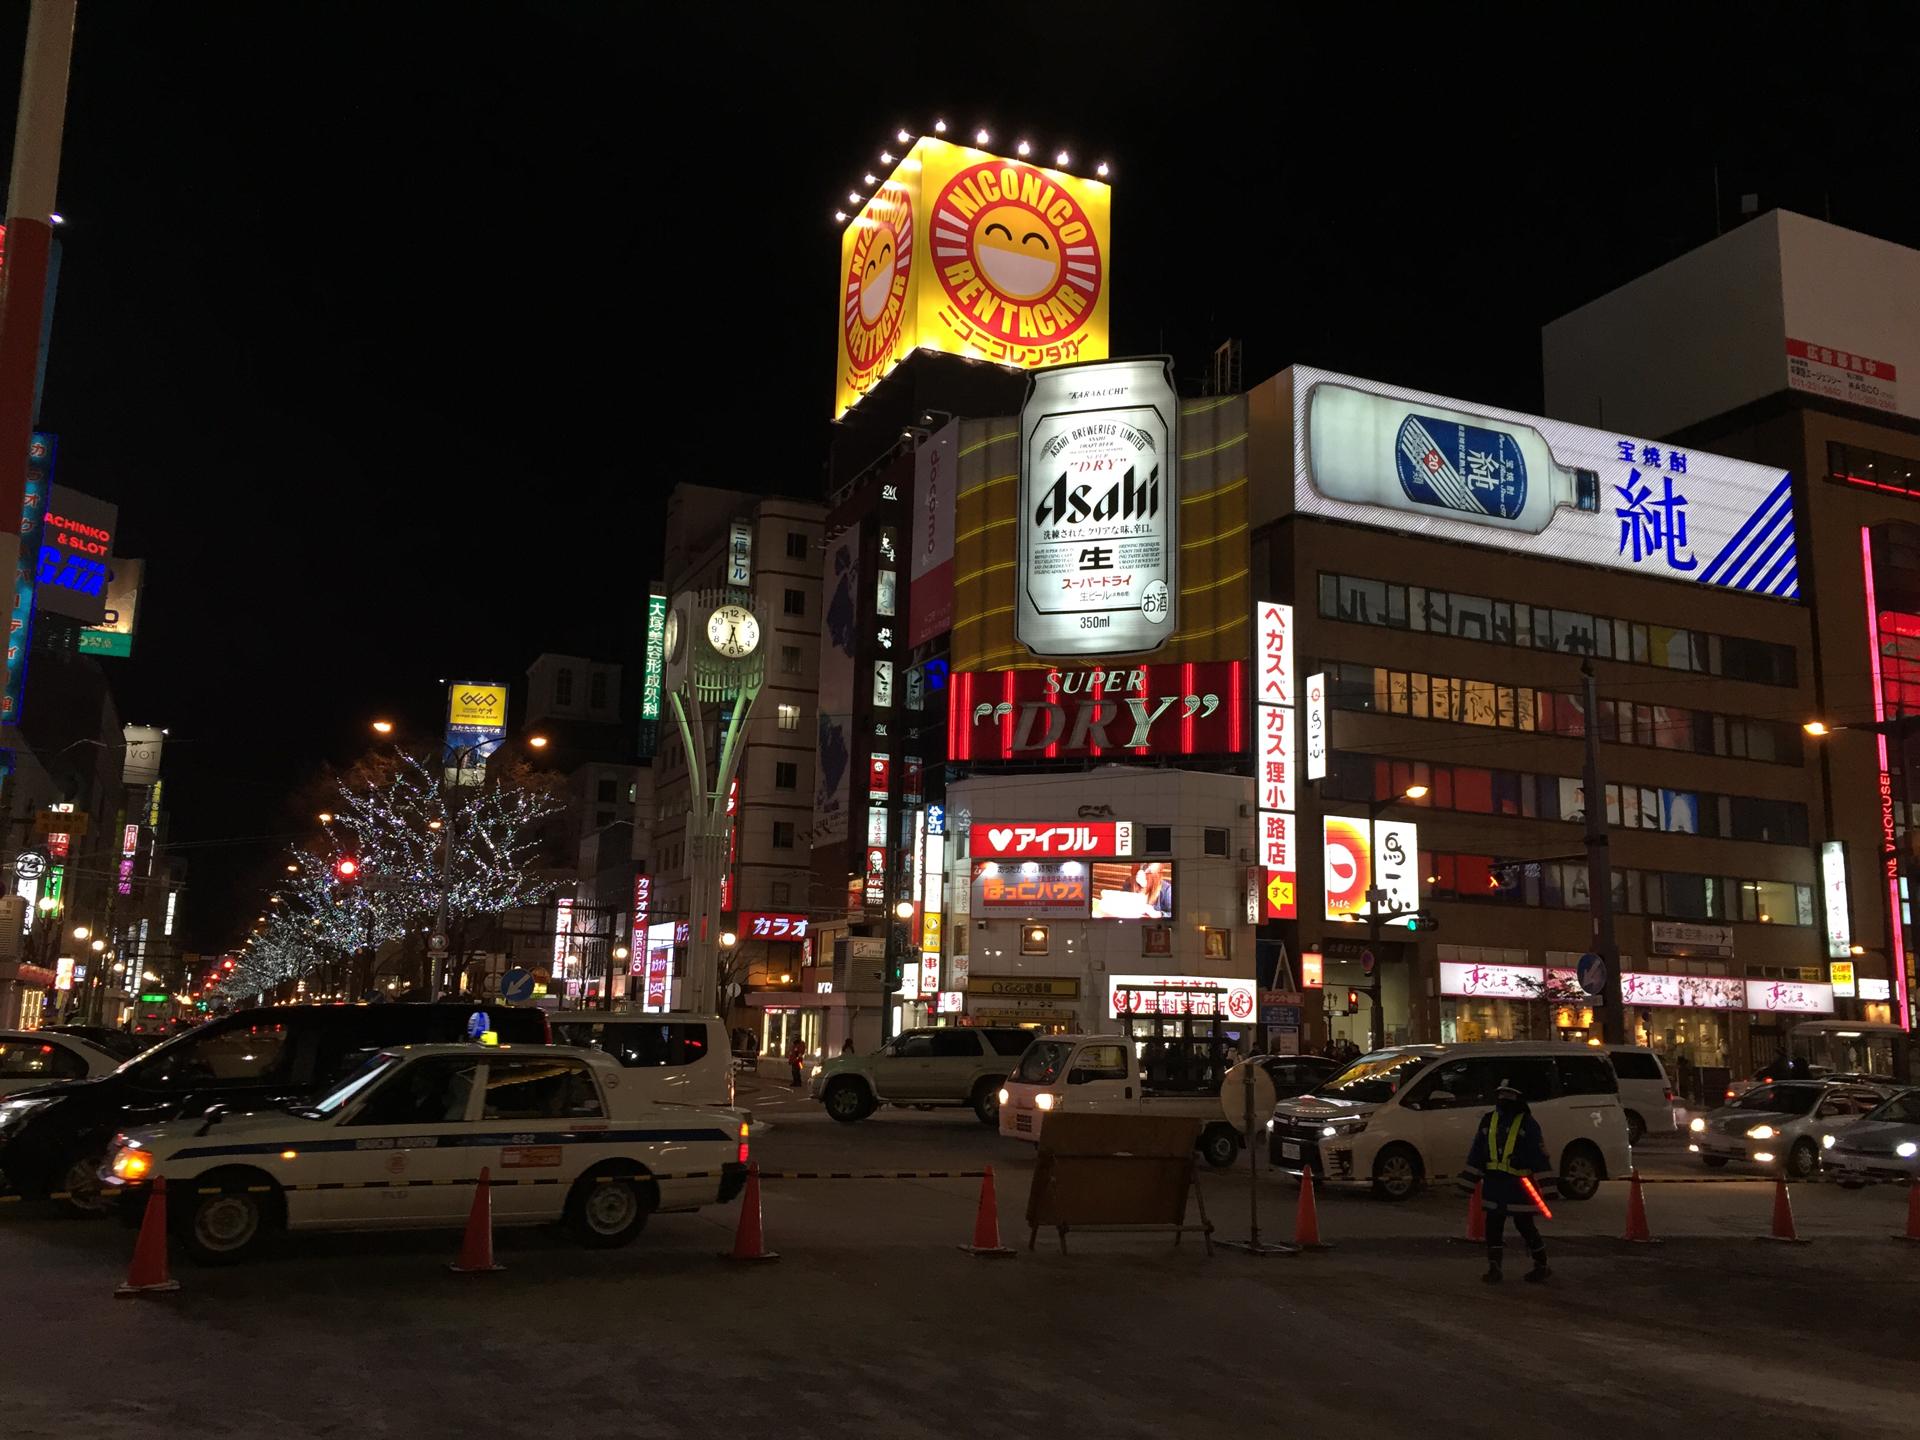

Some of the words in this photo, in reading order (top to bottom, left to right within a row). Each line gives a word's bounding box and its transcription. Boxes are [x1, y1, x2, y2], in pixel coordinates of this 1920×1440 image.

[947, 168, 1088, 245] NICONICO
[944, 261, 1087, 339] RENTACAR
[849, 274, 907, 363] RENTACAR
[938, 305, 1089, 366] ニコニコレンタカー
[1050, 436, 1070, 458] ASAHI
[1071, 424, 1117, 440] BREWERIES
[1119, 428, 1146, 452] LIMITED
[1617, 440, 1688, 475] 宝焼酎
[1428, 453, 1438, 469] 20
[1467, 450, 1500, 491] 純
[1035, 462, 1160, 528] Asahi
[44, 511, 110, 543] ACHINKO
[1613, 468, 1698, 571] 純
[57, 532, 68, 545] &
[70, 536, 108, 557] SLOT
[733, 527, 748, 581] 三信ビル
[1079, 546, 1114, 571] 生
[35, 545, 105, 597] GAIA
[1061, 574, 1132, 589] スーパードライ
[721, 611, 728, 619] 11
[730, 609, 739, 617] 12
[1143, 592, 1167, 612] お酒
[714, 617, 723, 625] 10
[1080, 616, 1110, 629] 350ml
[643, 602, 665, 718] 大塚美容形成外科
[1043, 670, 1147, 694] SUPER
[1880, 773, 1895, 840] HOKUSEI
[1015, 826, 1098, 851] アイフル
[1119, 826, 1130, 851] 3F
[635, 878, 650, 922] カラオケ
[634, 930, 644, 946] BIG
